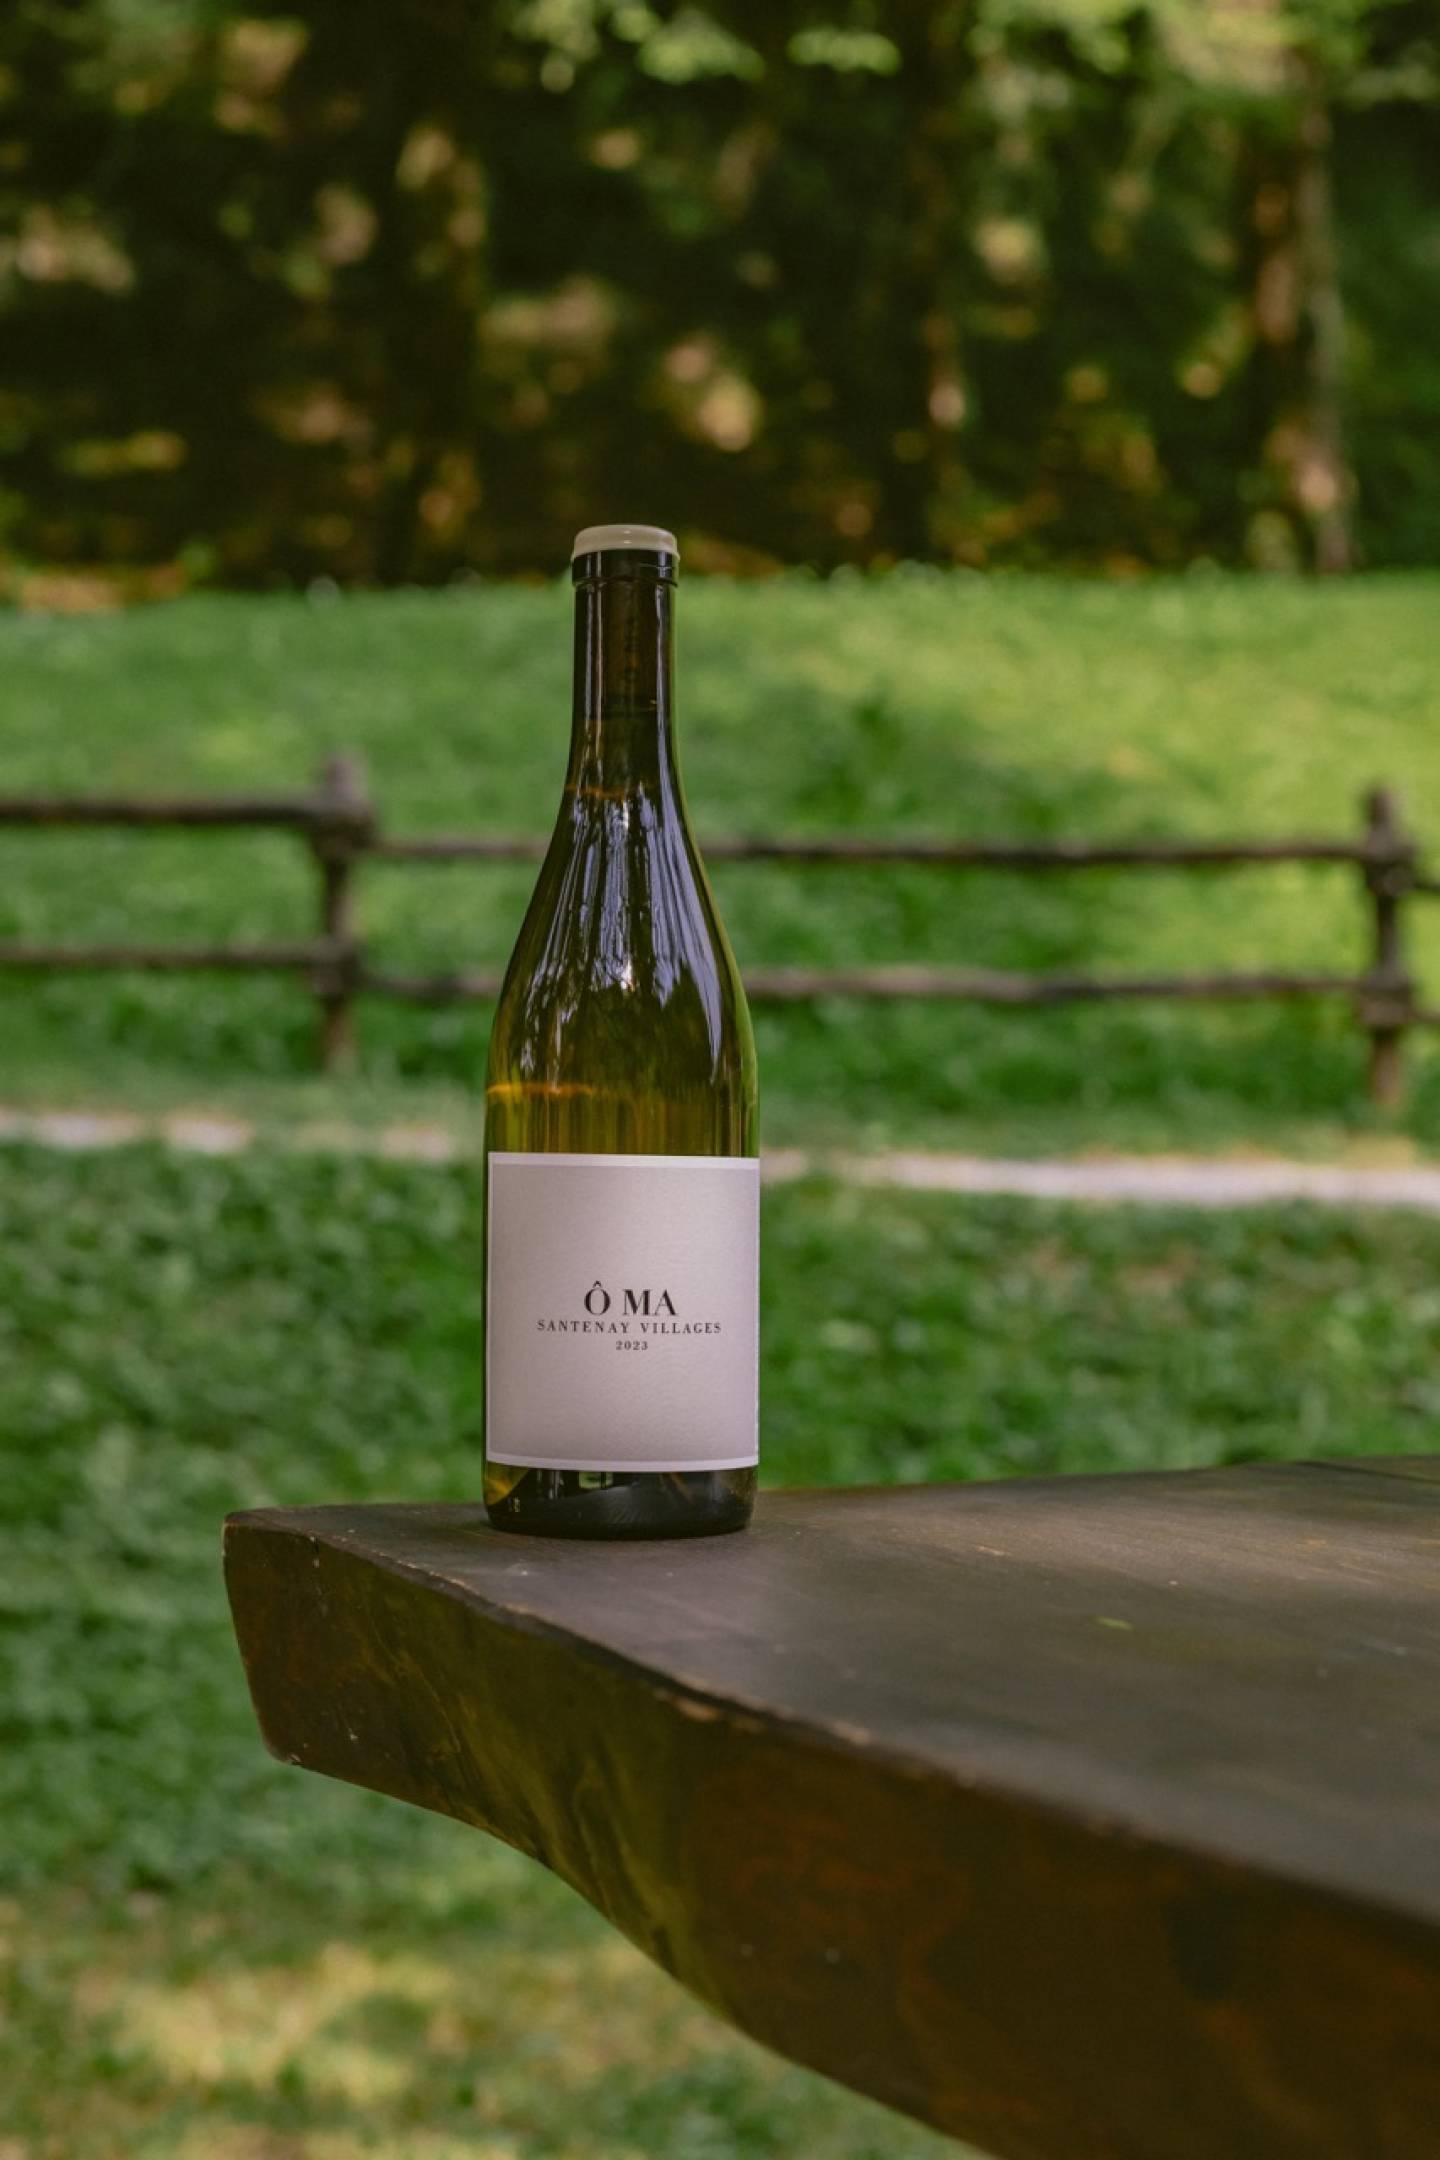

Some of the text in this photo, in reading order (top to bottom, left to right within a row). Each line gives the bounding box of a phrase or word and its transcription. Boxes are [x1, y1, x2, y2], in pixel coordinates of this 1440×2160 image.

[583, 1280, 679, 1316] Ô MA
[536, 1319, 722, 1334] SANTENAY VILLAGES
[615, 1340, 649, 1351] 2023
